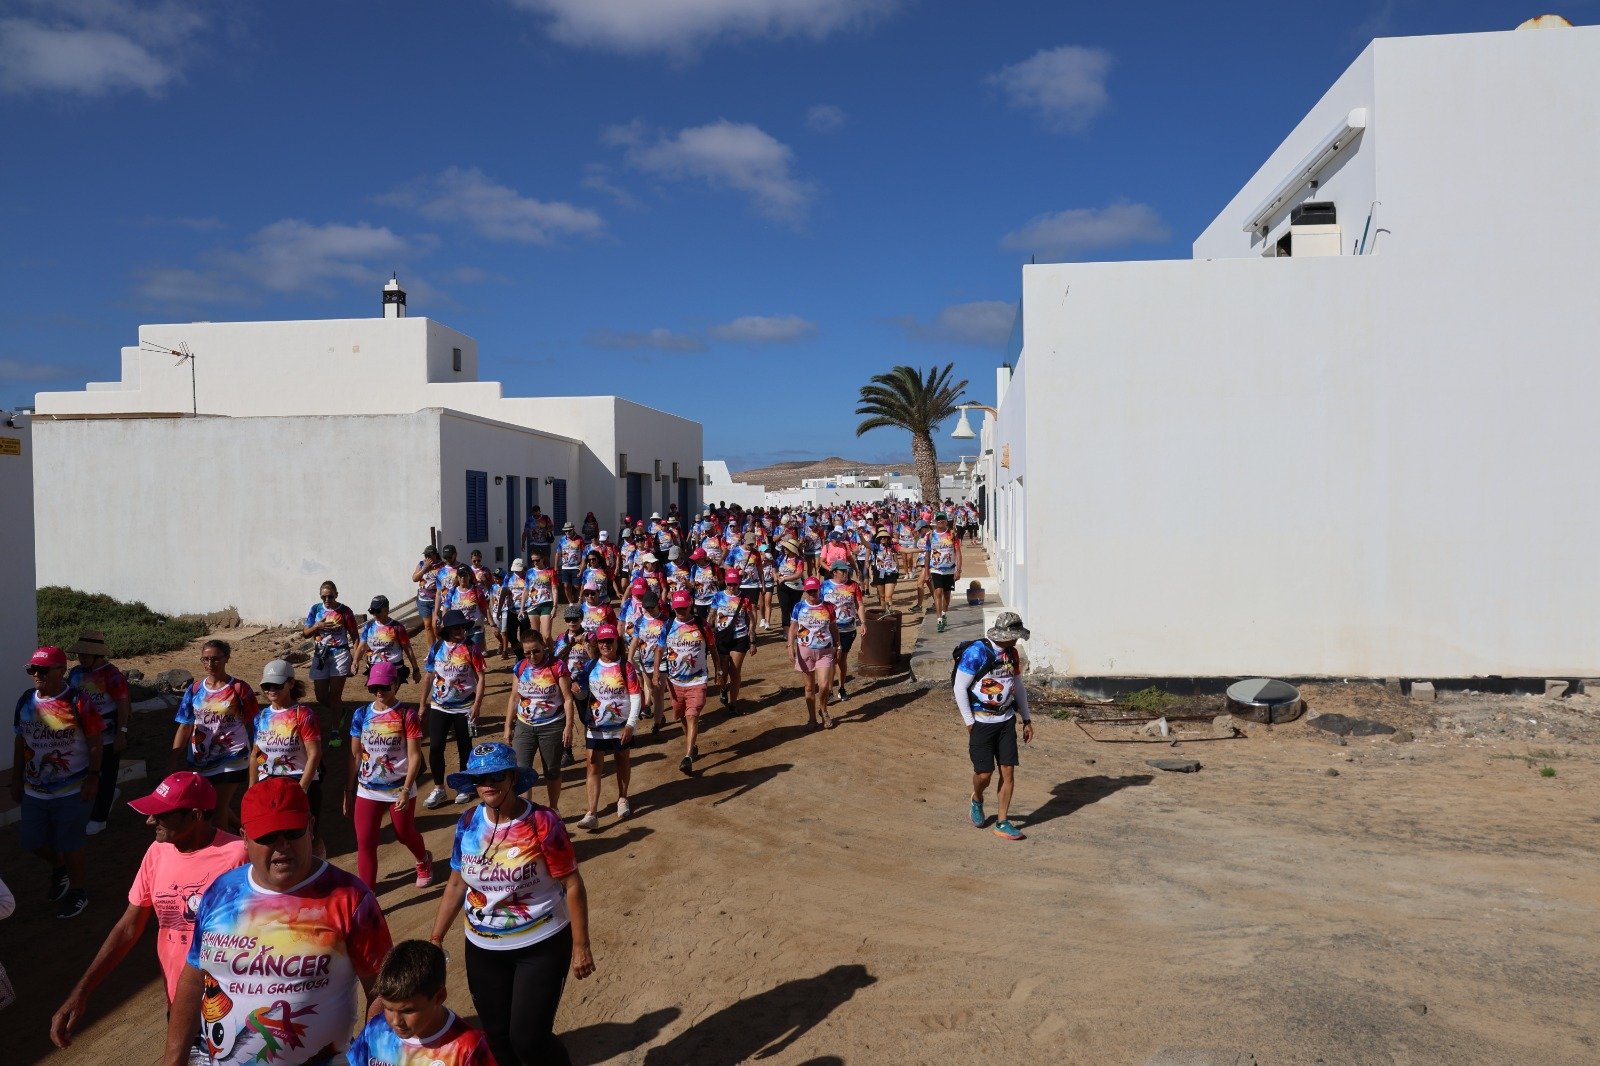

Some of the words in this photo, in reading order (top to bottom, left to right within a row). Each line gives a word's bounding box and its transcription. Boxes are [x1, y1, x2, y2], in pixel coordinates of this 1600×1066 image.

[528, 683, 557, 695] CÁNCER
[33, 727, 75, 740] CÁNCER
[267, 734, 300, 746] CÁNCER
[368, 735, 402, 746] CÁNCER
[467, 866, 477, 875] EL
[479, 861, 538, 882] CÁNCER
[214, 950, 228, 963] EL
[231, 945, 331, 977] CÁNCER
[229, 982, 245, 994] EN
[247, 983, 263, 994] LA
[267, 978, 329, 994] GRACIOSA
